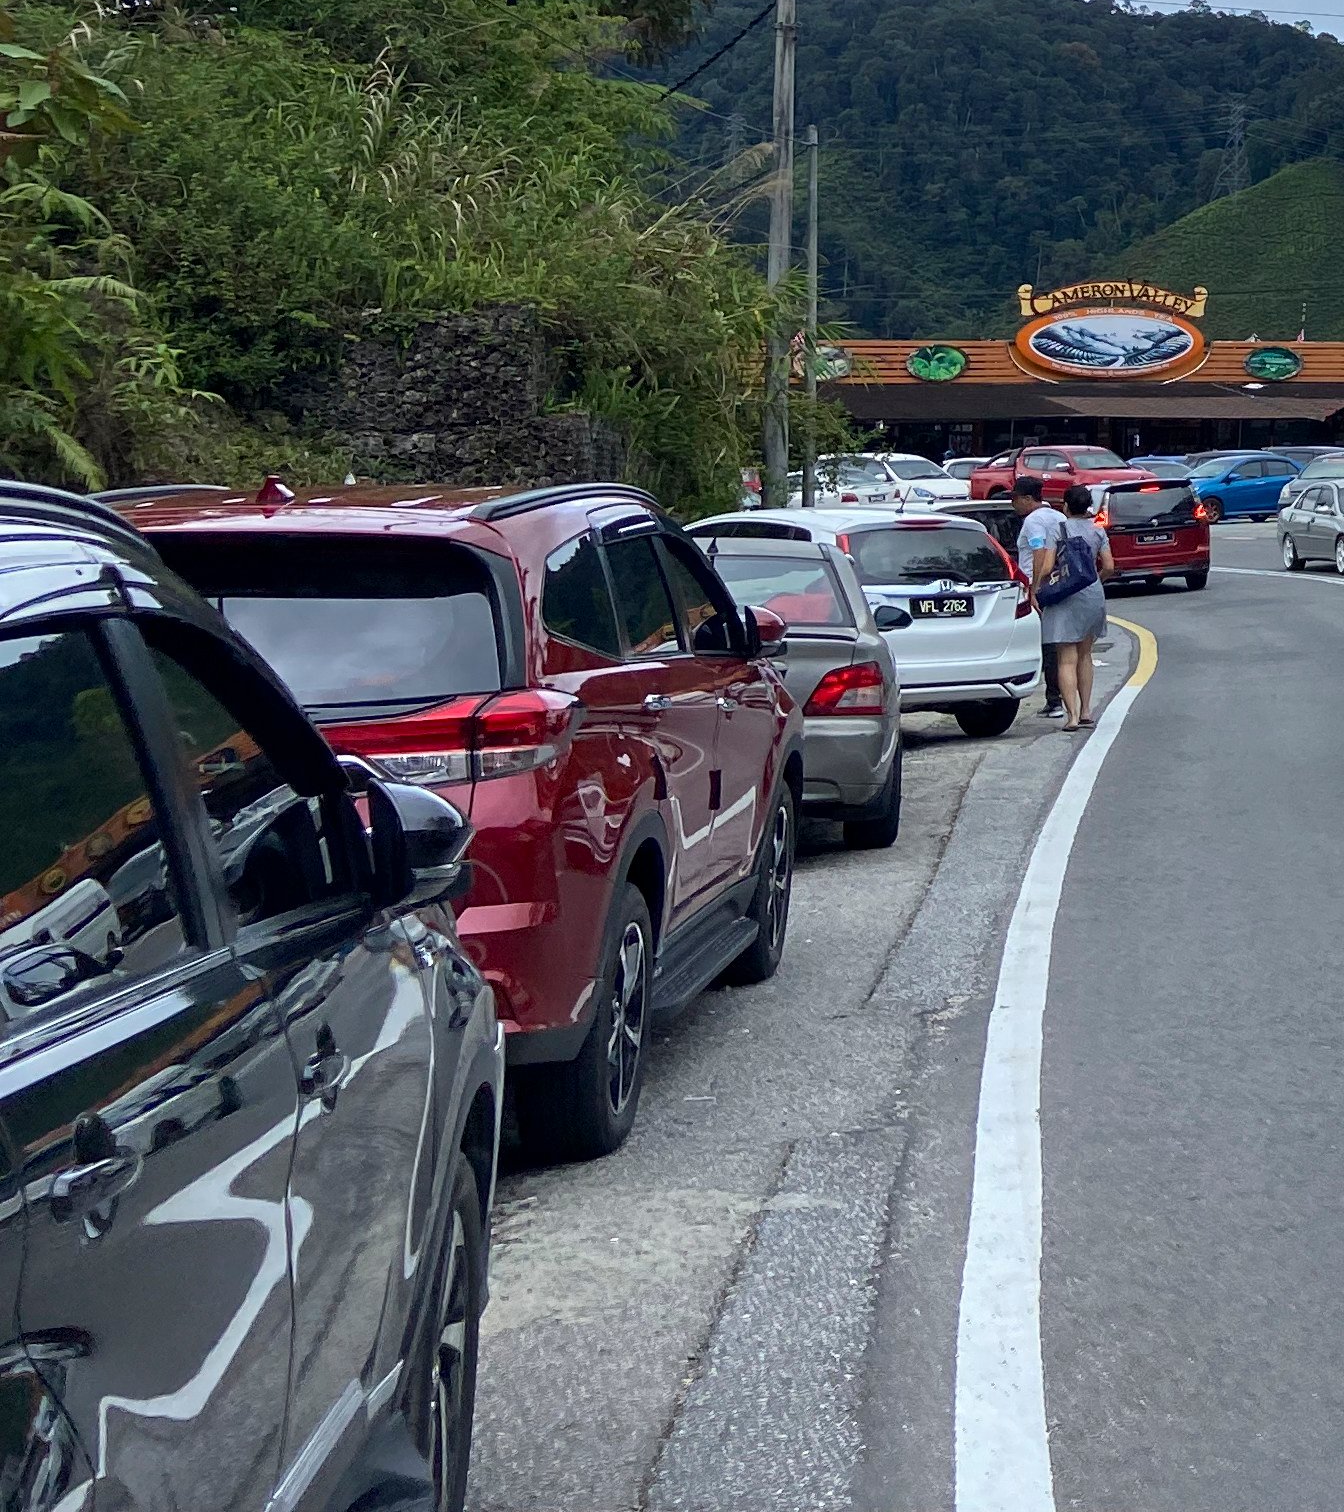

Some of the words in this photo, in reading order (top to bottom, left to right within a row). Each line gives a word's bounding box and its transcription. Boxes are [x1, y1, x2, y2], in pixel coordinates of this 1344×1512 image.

[1031, 284, 1125, 316] CAMERON
[1127, 278, 1197, 316] VALLEY
[919, 600, 939, 613] VFL
[943, 599, 967, 612] 2762
